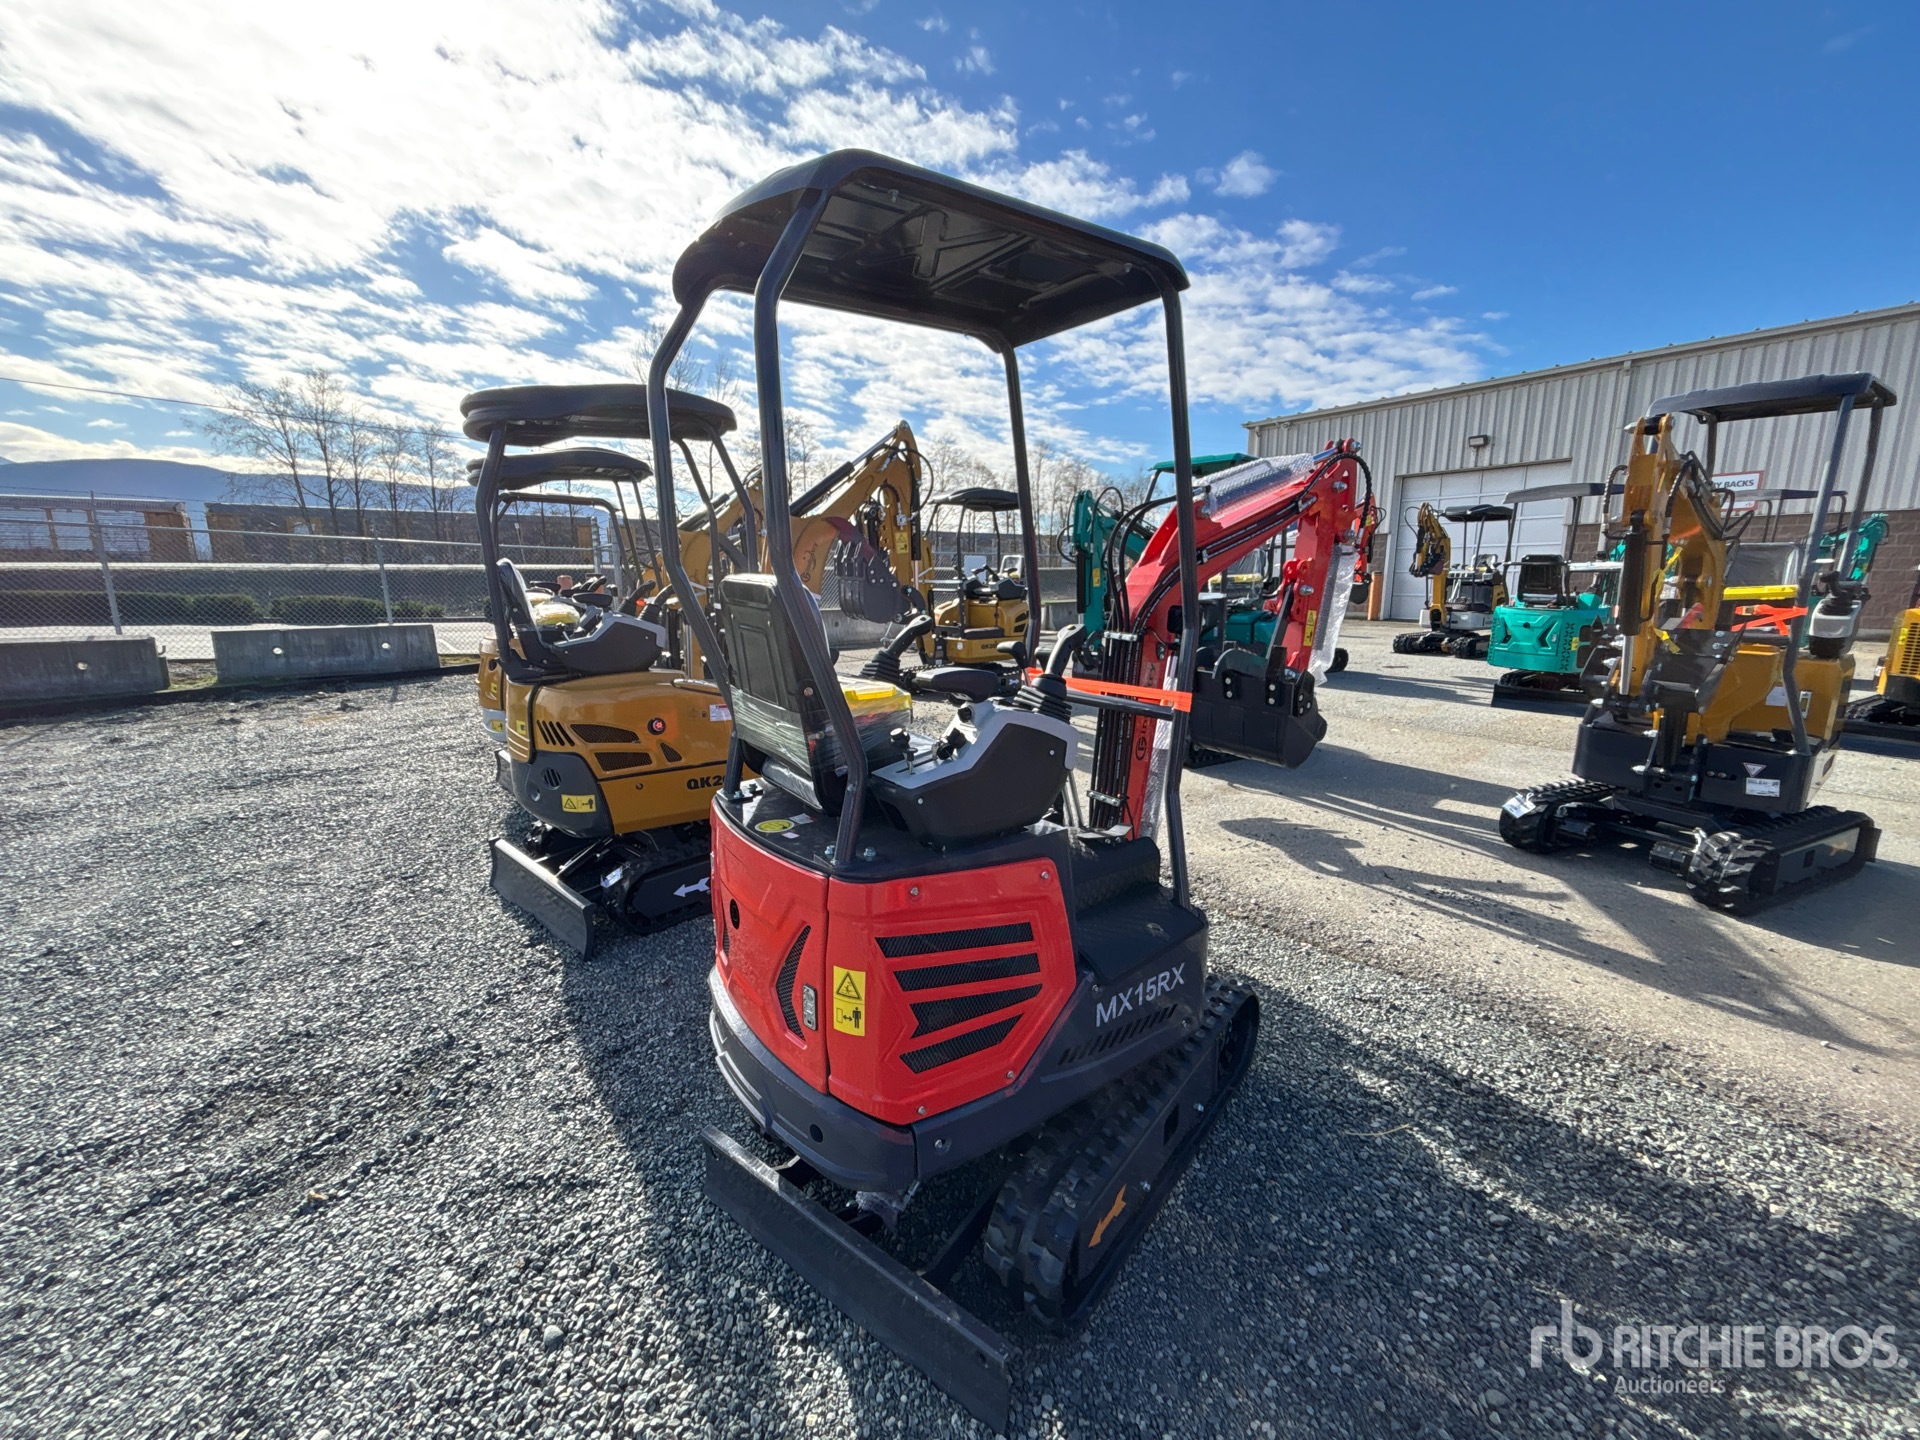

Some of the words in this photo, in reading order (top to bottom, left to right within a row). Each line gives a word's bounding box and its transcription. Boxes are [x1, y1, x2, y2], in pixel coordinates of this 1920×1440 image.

[1724, 479, 1755, 488] BACKS
[686, 775, 725, 790] QK2
[1096, 962, 1185, 1027] MX15RX
